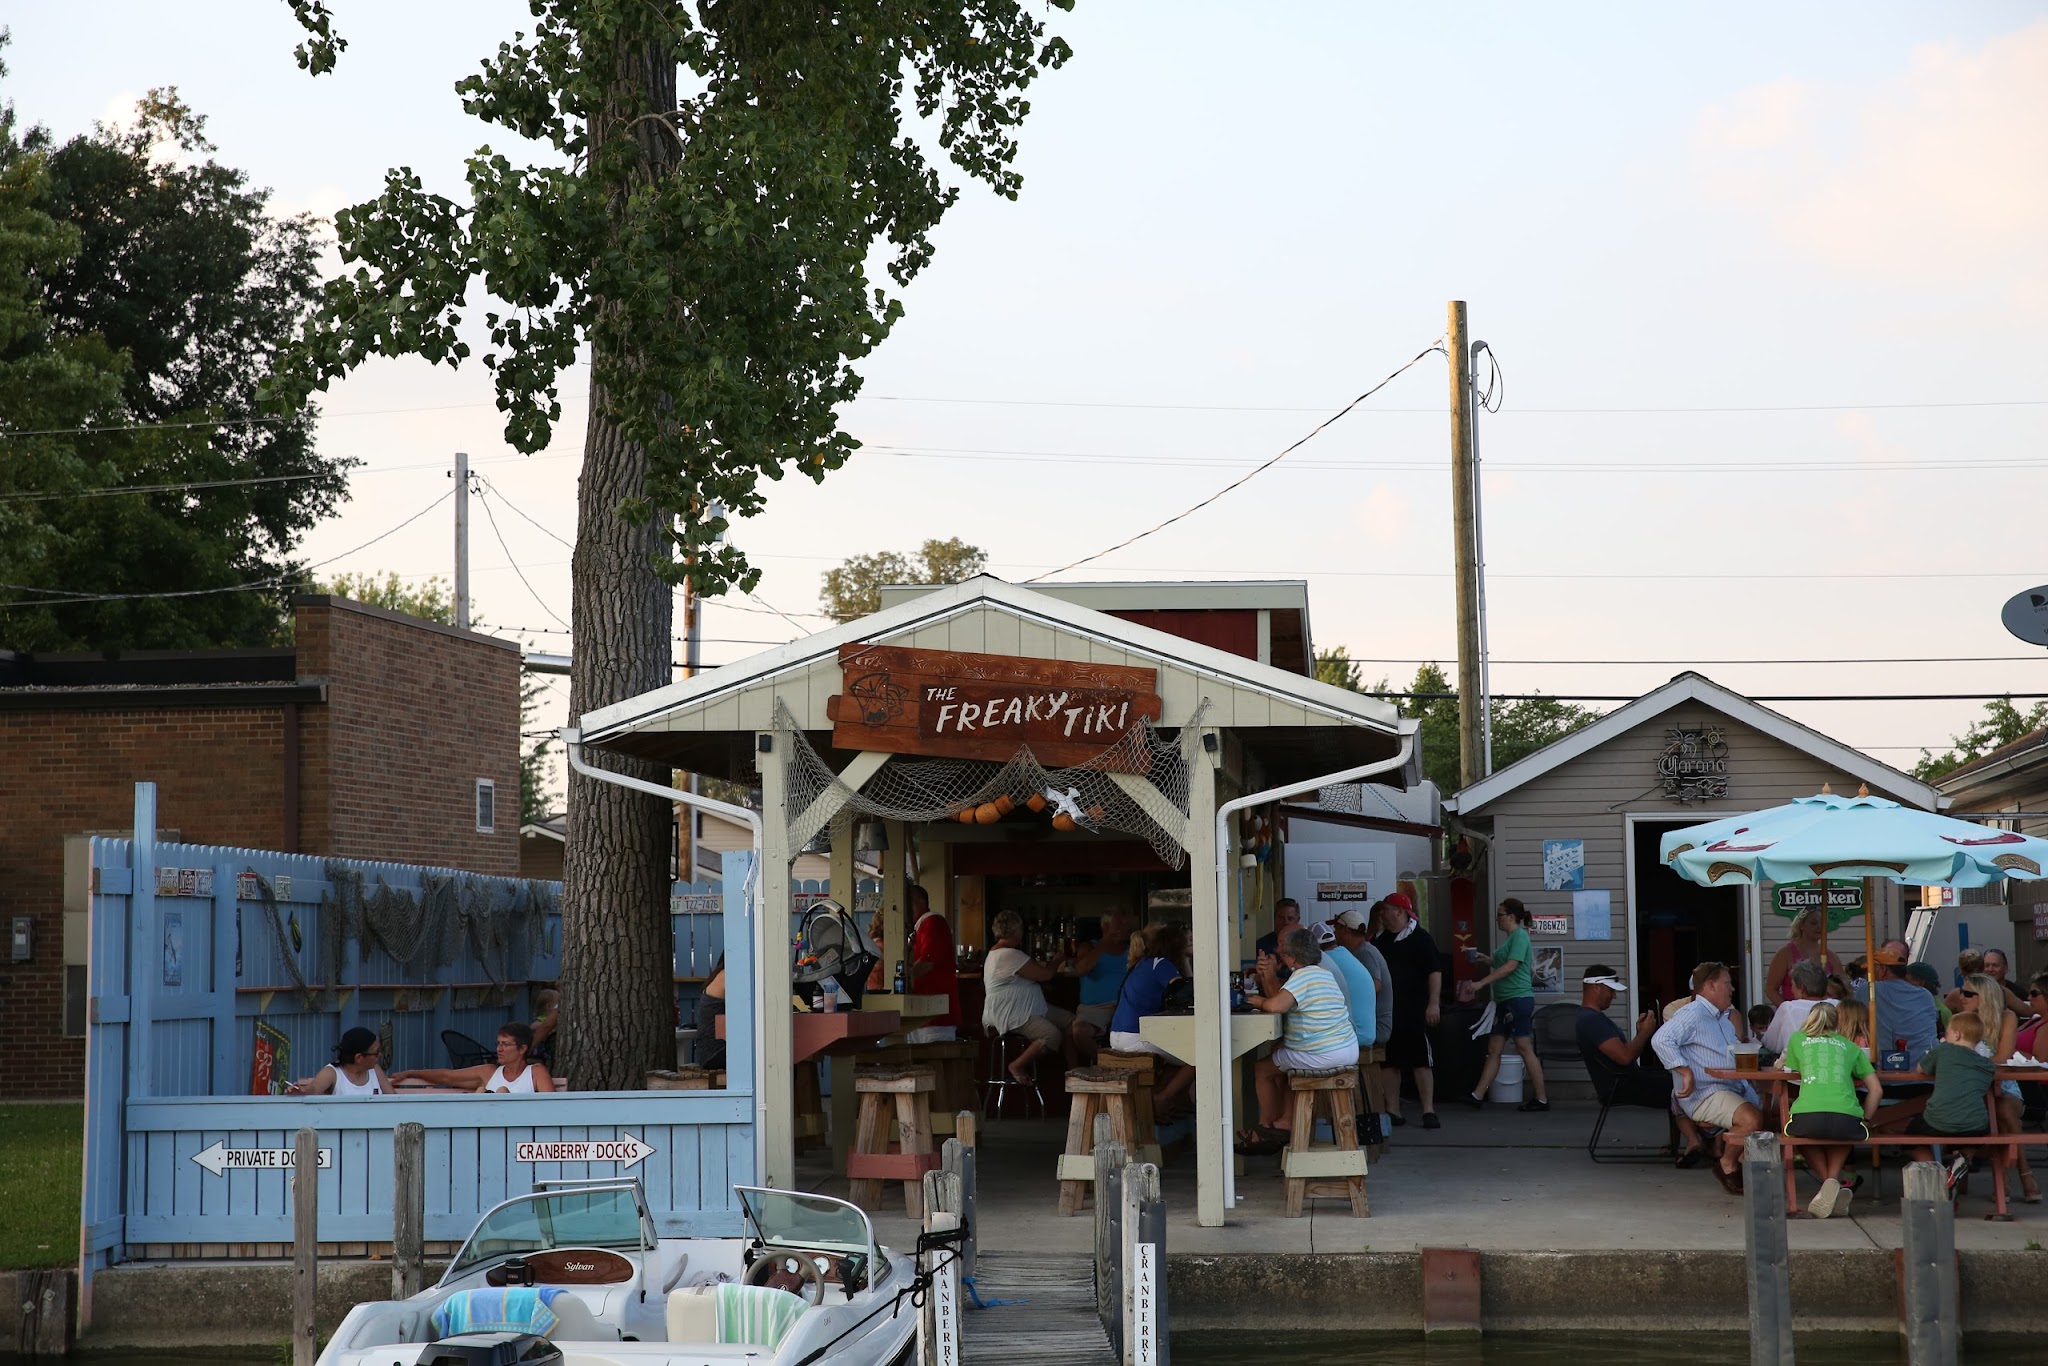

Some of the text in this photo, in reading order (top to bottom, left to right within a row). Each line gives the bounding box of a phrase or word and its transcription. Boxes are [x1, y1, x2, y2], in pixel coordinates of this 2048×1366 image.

[927, 687, 958, 701] THE
[935, 691, 1129, 737] FREAKY TIKI
[1658, 755, 1726, 776] Corona
[1321, 892, 1342, 900] belly
[2035, 917, 2048, 926] ALLO
[226, 1150, 276, 1166] PRIVATE
[519, 1143, 638, 1160] CRANBERRY DOCKS
[564, 1262, 595, 1272] Sylvan
[940, 1252, 951, 1366] CRANBERRY
[1141, 1245, 1150, 1362] CRANBERRY
